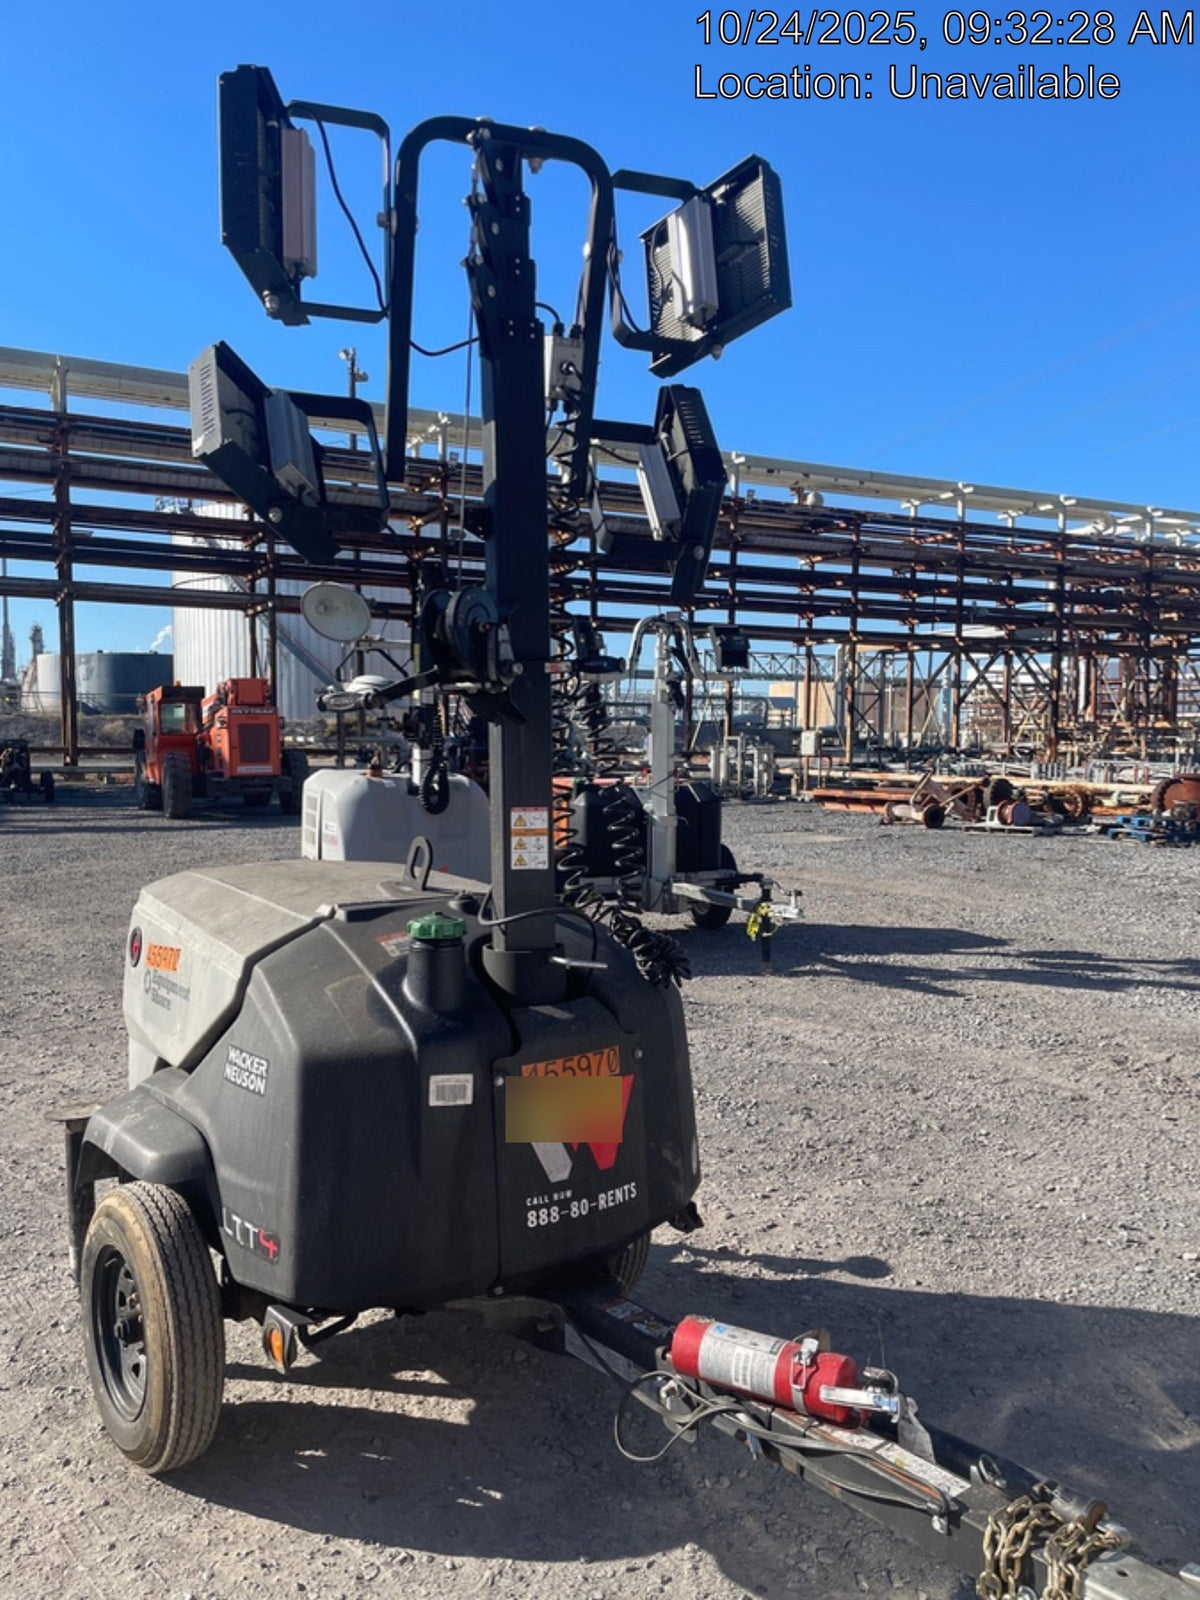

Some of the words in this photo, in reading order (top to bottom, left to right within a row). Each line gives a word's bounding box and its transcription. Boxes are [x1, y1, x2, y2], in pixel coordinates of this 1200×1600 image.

[228, 1045, 268, 1078] WACKER
[223, 1062, 266, 1095] NEUSON
[525, 1194, 549, 1206] CALL
[526, 1181, 638, 1228] 888-80-RENTS
